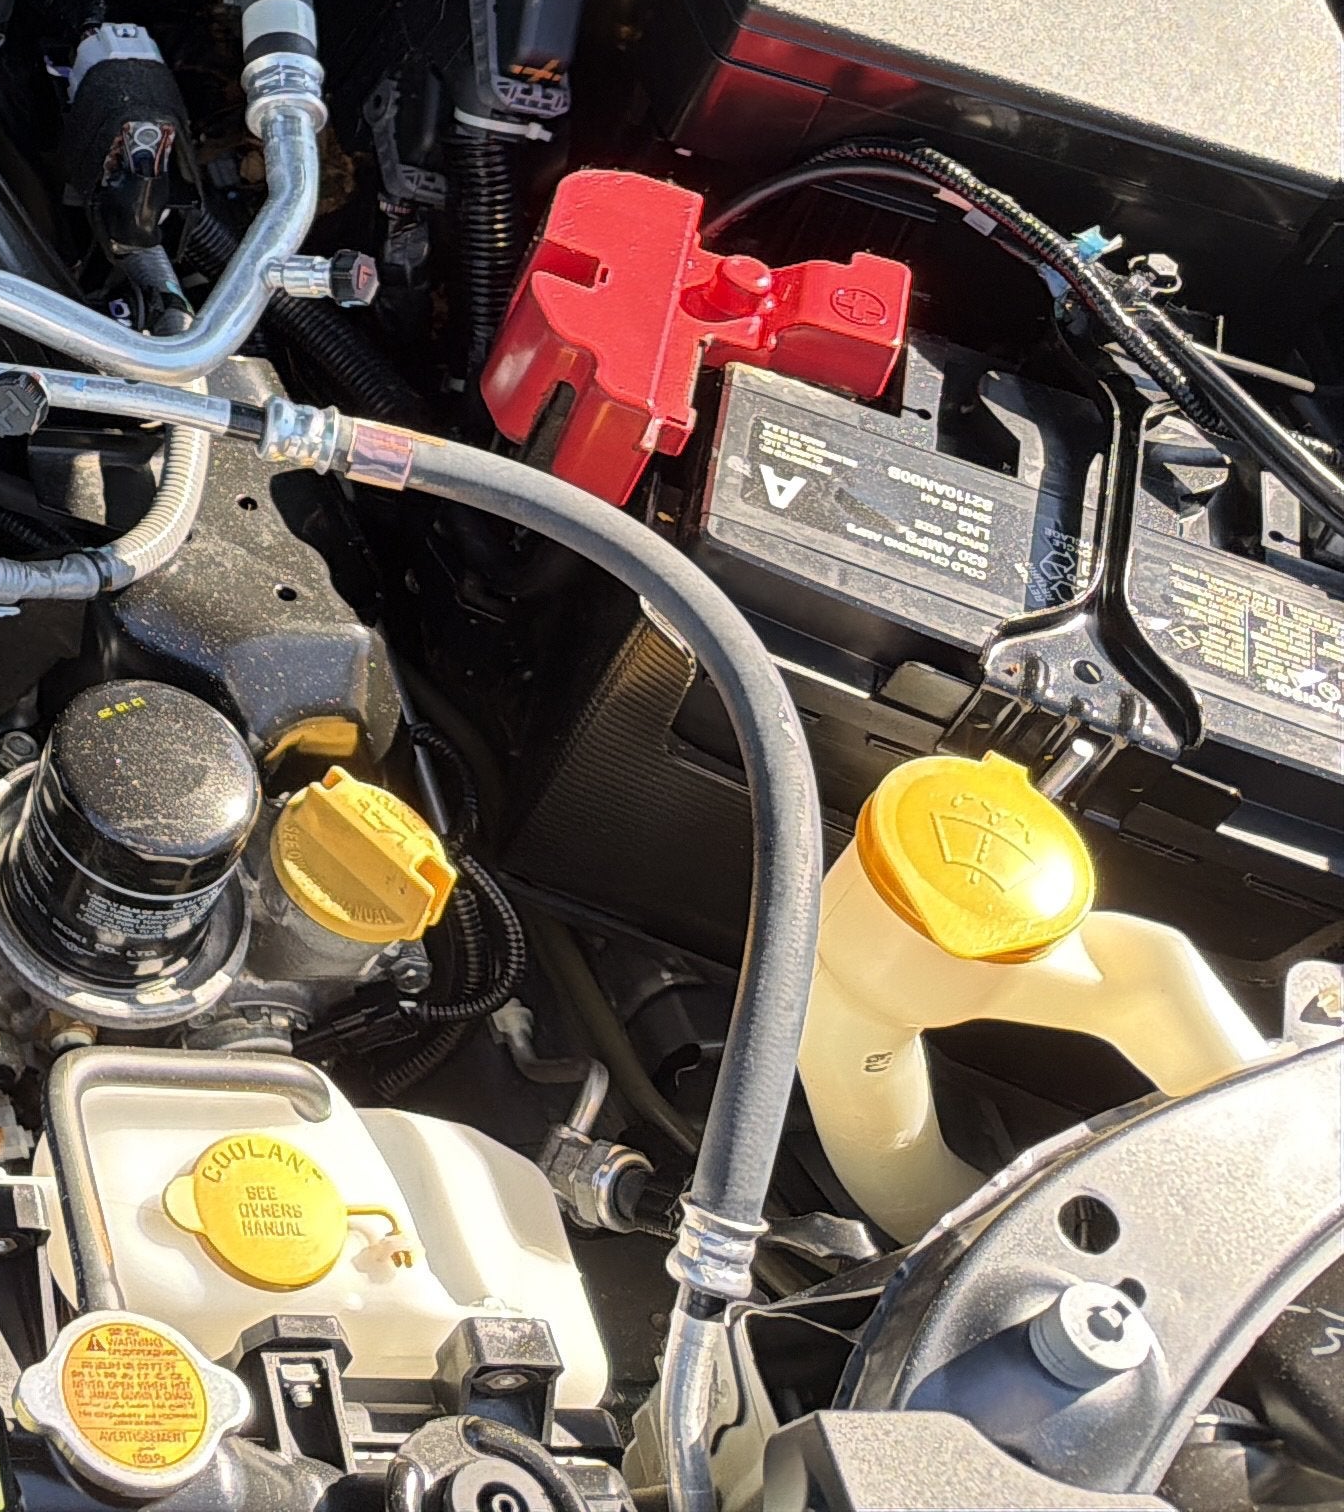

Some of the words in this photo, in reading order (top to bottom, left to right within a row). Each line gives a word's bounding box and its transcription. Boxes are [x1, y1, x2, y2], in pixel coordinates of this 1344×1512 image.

[955, 518, 991, 540] LN2
[904, 530, 955, 556] AMPS
[956, 548, 989, 568] 620
[950, 560, 987, 580] COLD
[245, 1185, 278, 1201] SEE
[238, 1202, 303, 1219] OWNERS
[241, 1220, 307, 1237] MANUAL
[106, 1336, 164, 1348] WARNING
